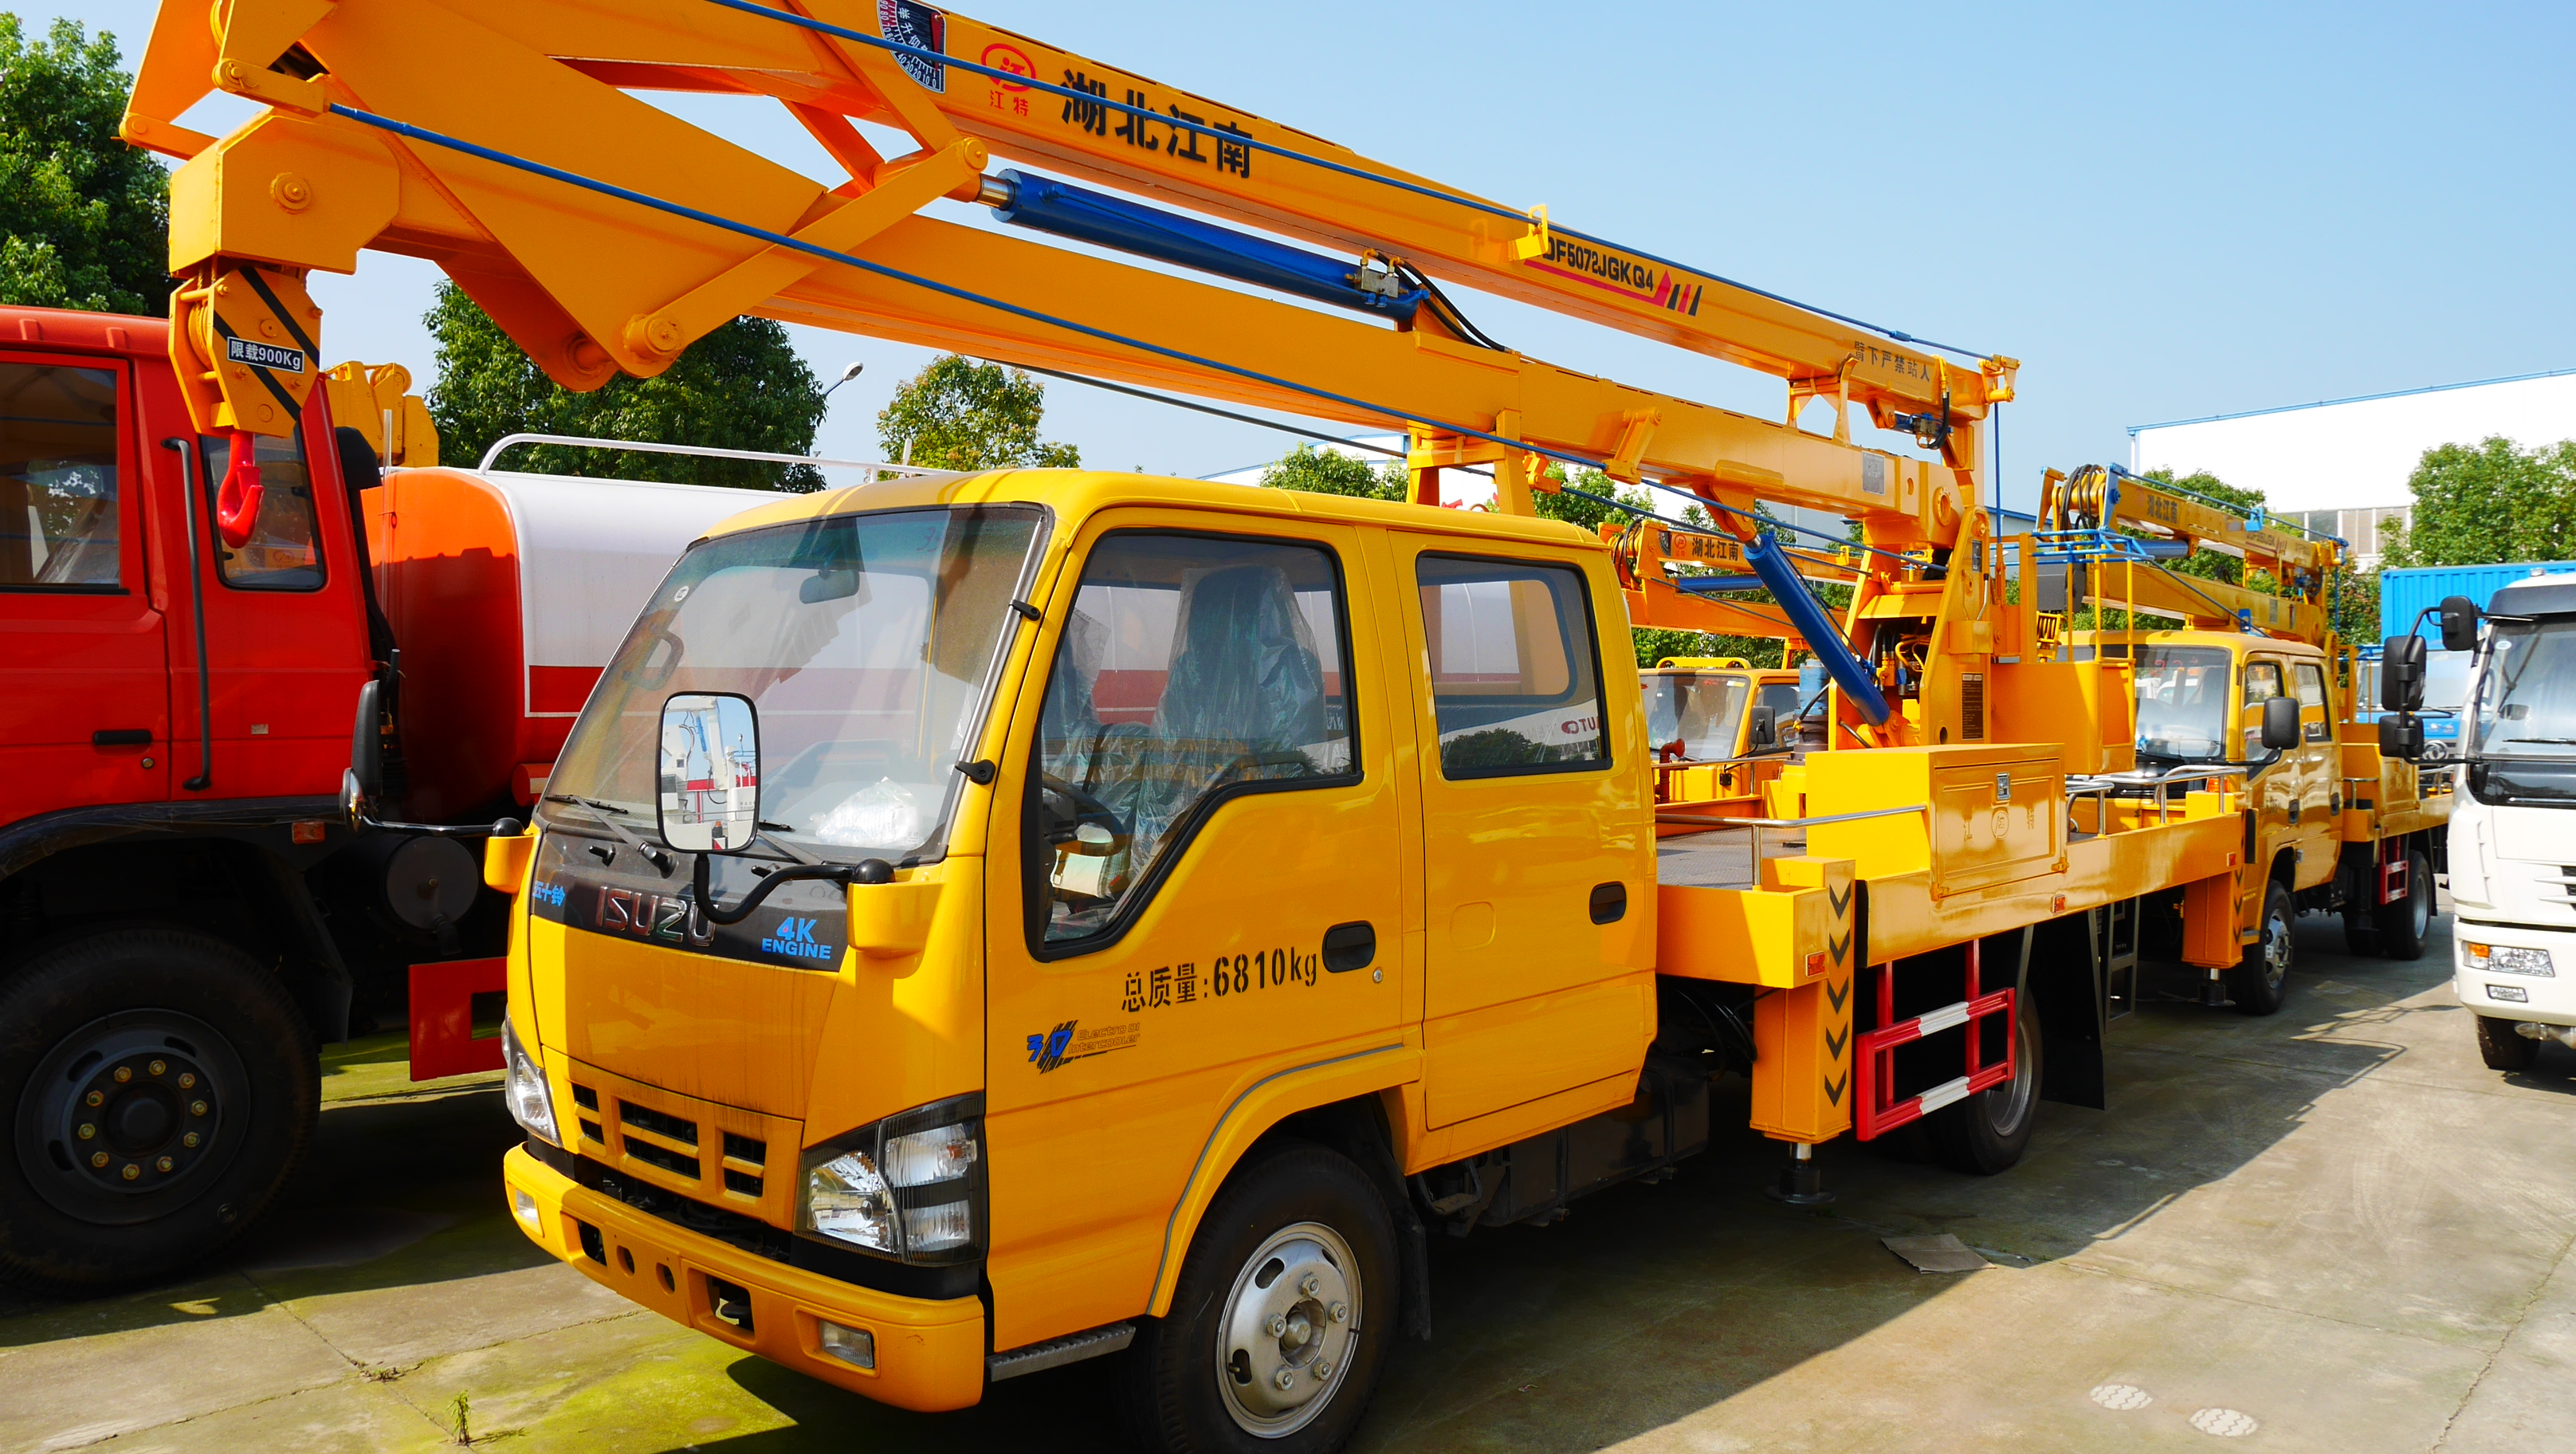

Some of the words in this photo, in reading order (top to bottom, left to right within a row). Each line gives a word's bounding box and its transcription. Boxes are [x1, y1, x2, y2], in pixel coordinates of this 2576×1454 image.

[897, 53, 907, 64] 40
[905, 62, 914, 73] 30
[913, 69, 921, 80] 20
[922, 74, 930, 85] 10
[932, 78, 937, 89] 0
[990, 89, 1029, 116] 江特
[1058, 69, 1254, 179] 湖北江南
[1537, 237, 1654, 292] DF5072JGKQ4
[231, 340, 301, 371] 限载900Kg
[1692, 536, 1739, 561] 湖北江南
[533, 881, 566, 907] 五十铃
[595, 886, 719, 947] ISUZU
[776, 916, 818, 944] 4K
[761, 937, 832, 961] ENGINE
